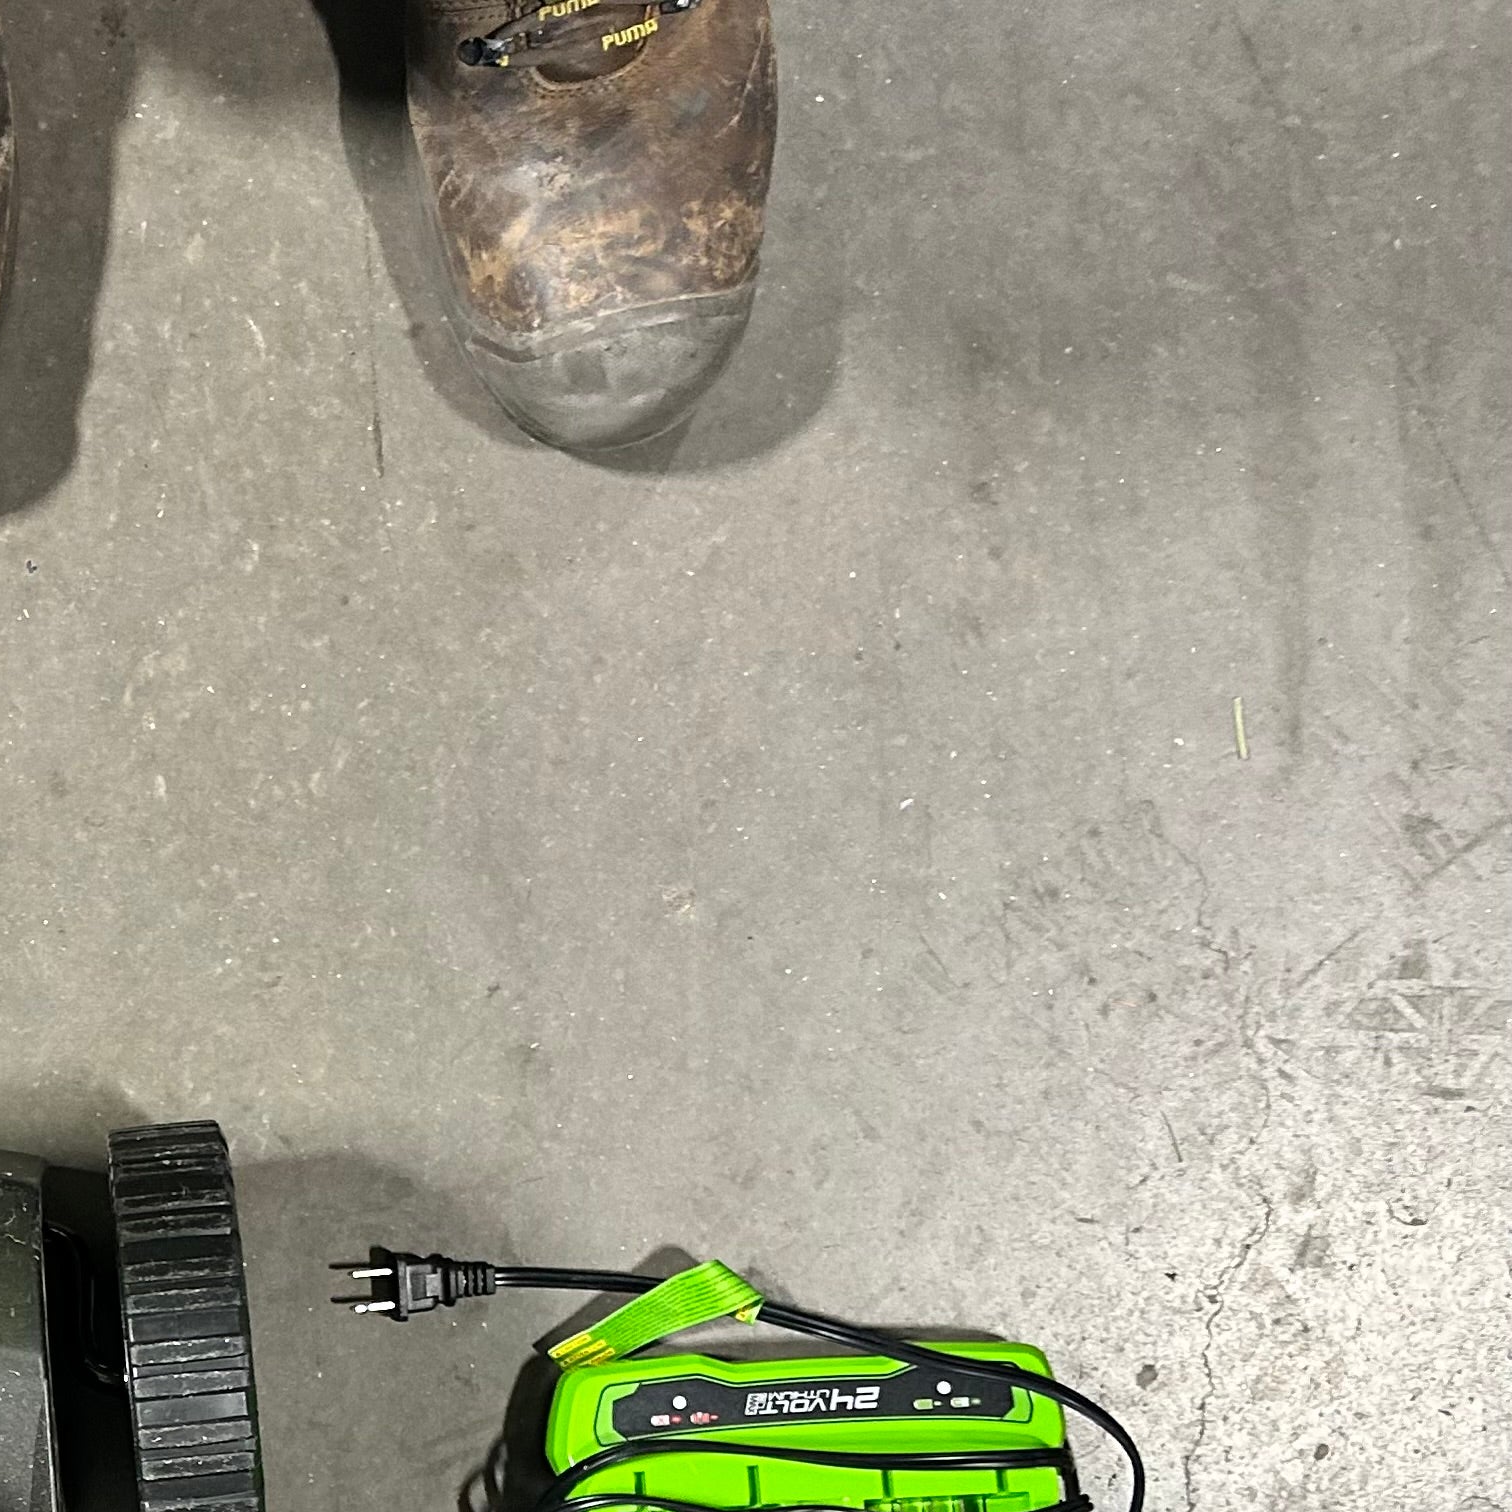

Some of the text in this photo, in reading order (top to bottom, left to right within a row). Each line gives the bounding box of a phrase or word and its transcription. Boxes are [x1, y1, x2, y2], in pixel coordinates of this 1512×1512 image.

[601, 17, 659, 51] PUMA
[758, 1386, 881, 1415] 24 VOLT
